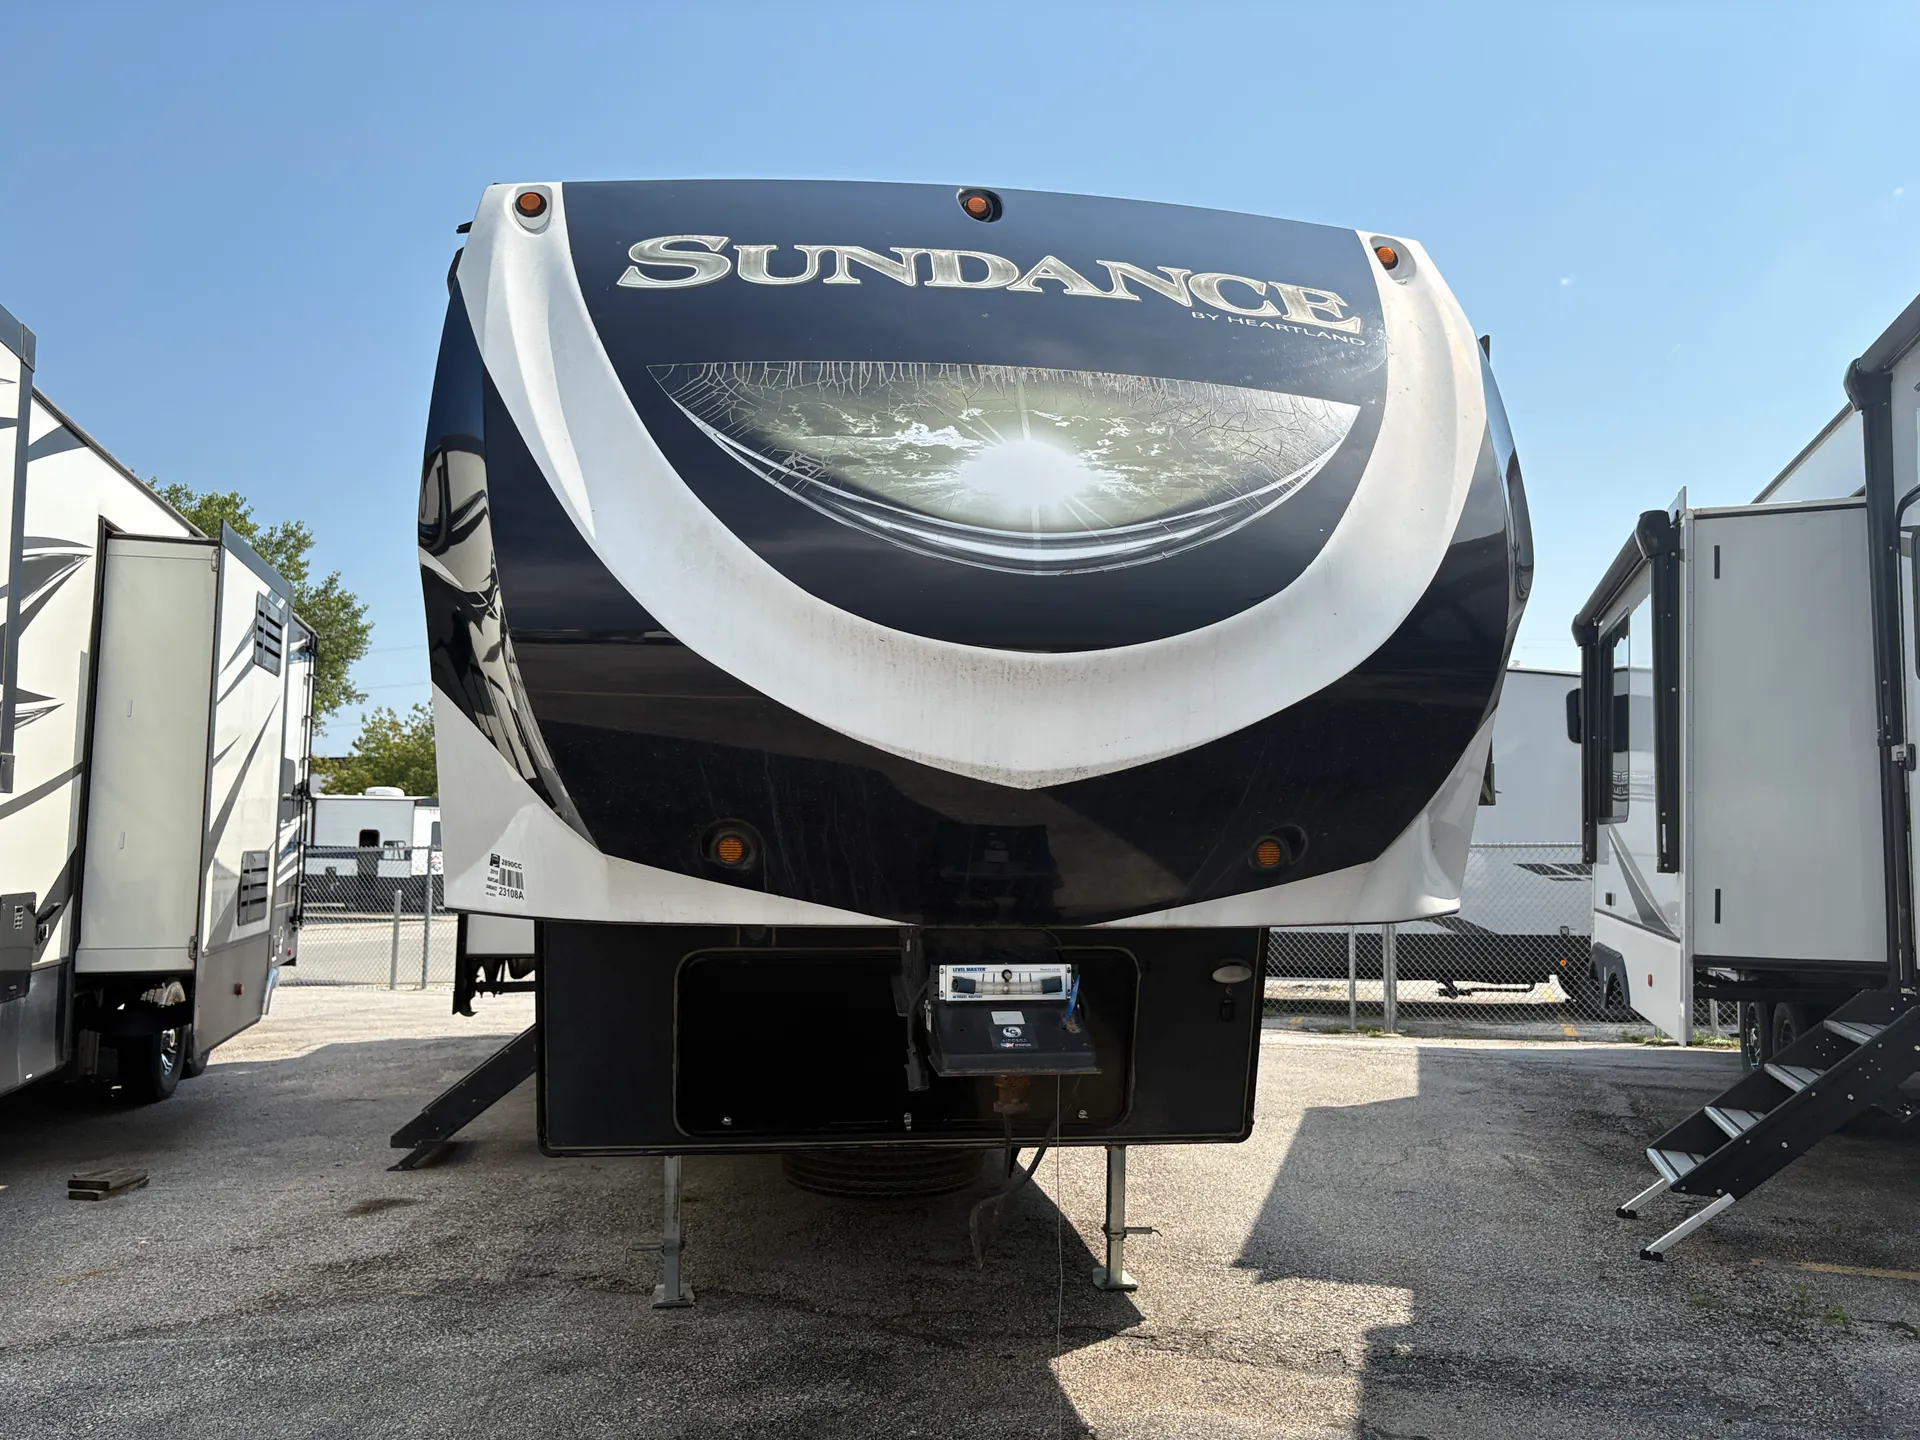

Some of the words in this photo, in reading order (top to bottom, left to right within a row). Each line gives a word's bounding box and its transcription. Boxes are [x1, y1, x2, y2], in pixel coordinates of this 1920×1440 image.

[616, 234, 1362, 335] SUNDANCE
[1191, 311, 1220, 321] BY
[1227, 316, 1367, 346] HEARTLAND
[498, 887, 525, 900] 23108A
